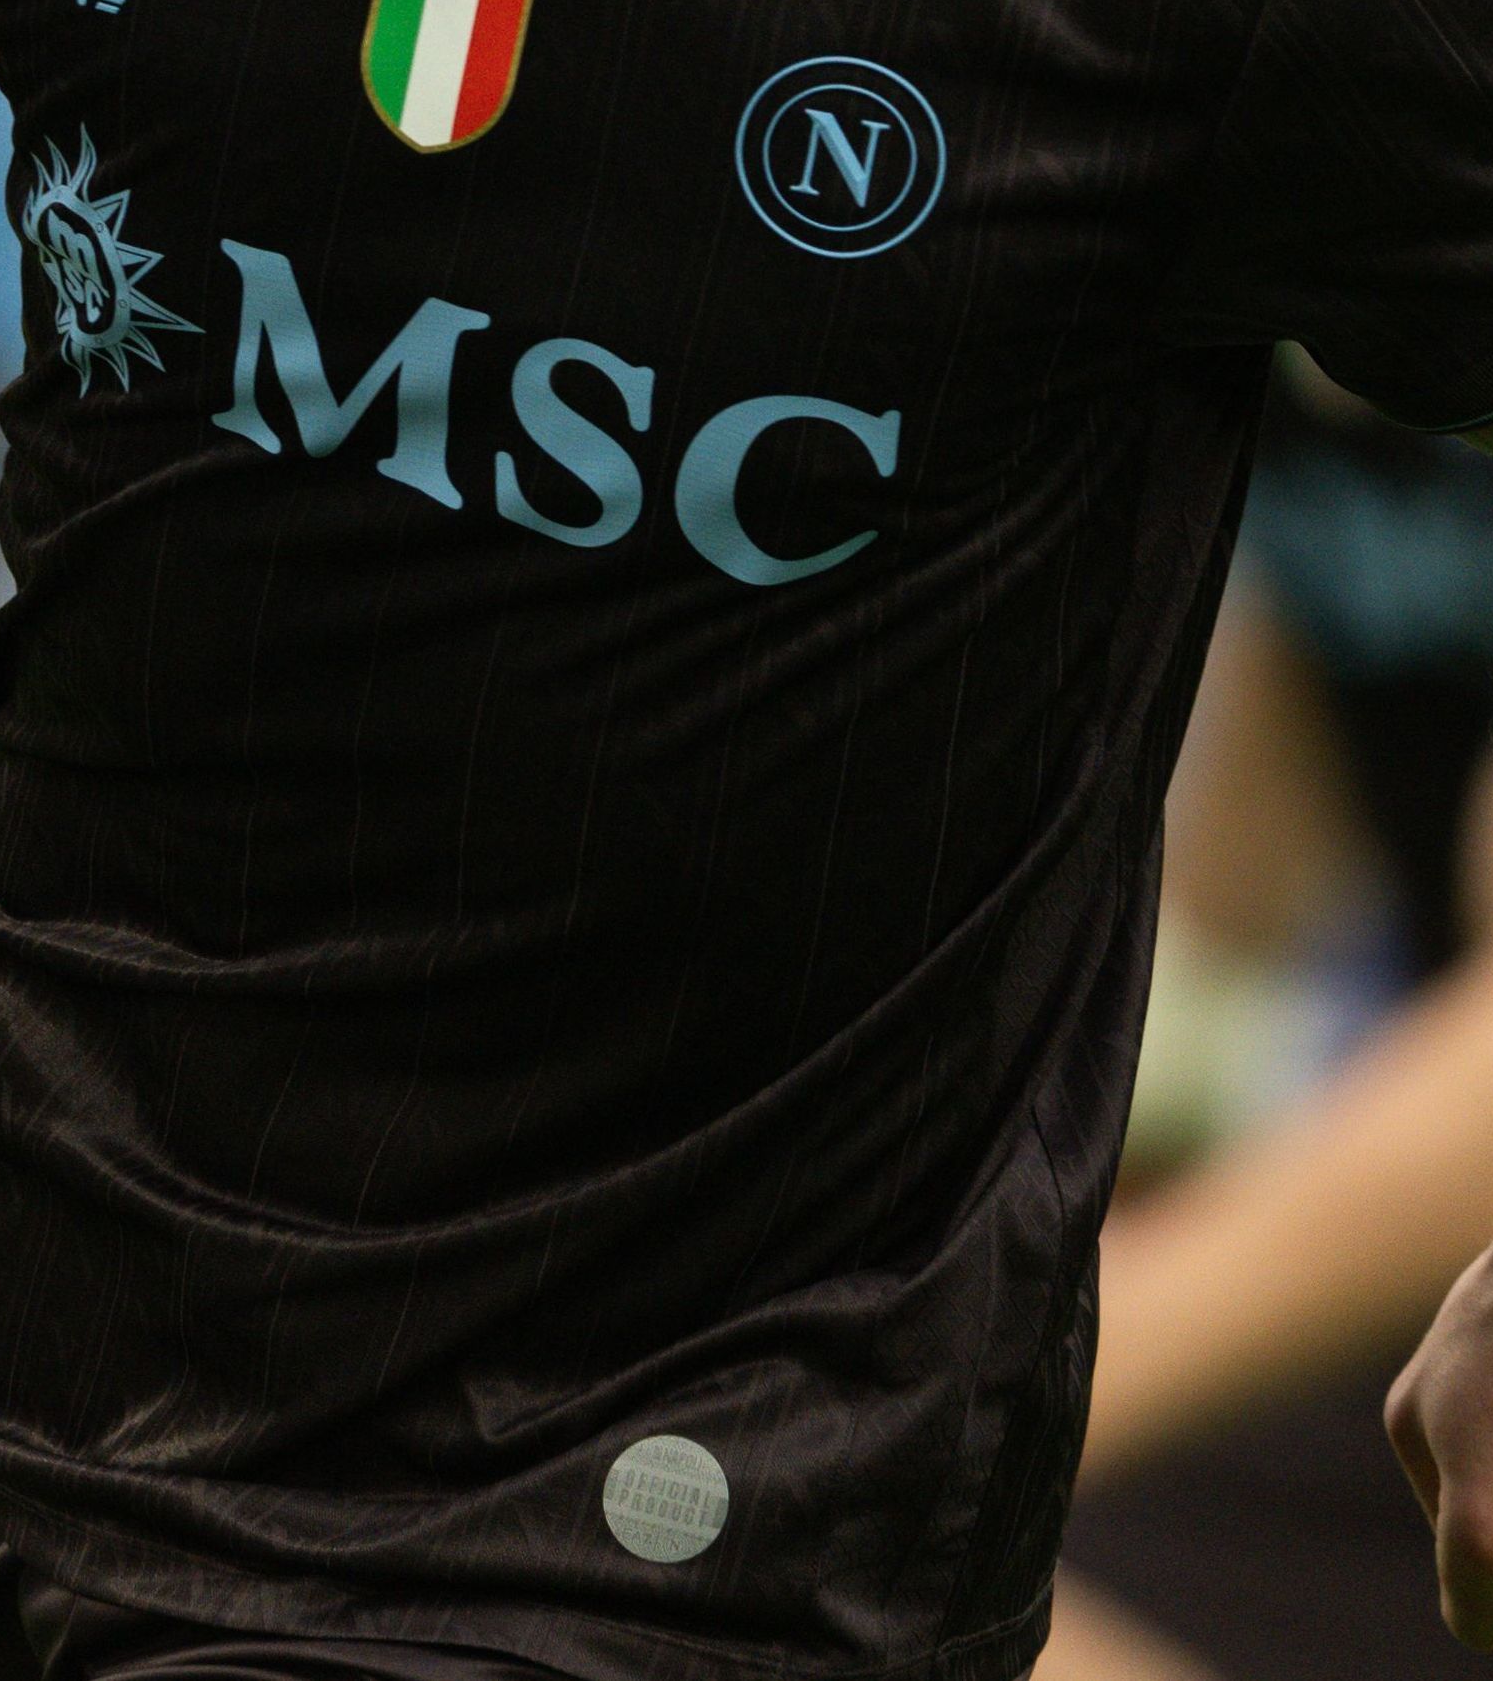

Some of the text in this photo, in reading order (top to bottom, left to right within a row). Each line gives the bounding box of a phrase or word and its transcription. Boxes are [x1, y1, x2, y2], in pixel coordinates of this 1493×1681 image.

[789, 108, 891, 208] N
[213, 237, 902, 586] MSC
[617, 1487, 709, 1528] PRODUCT
[624, 1469, 713, 1509] OFFICIAL
